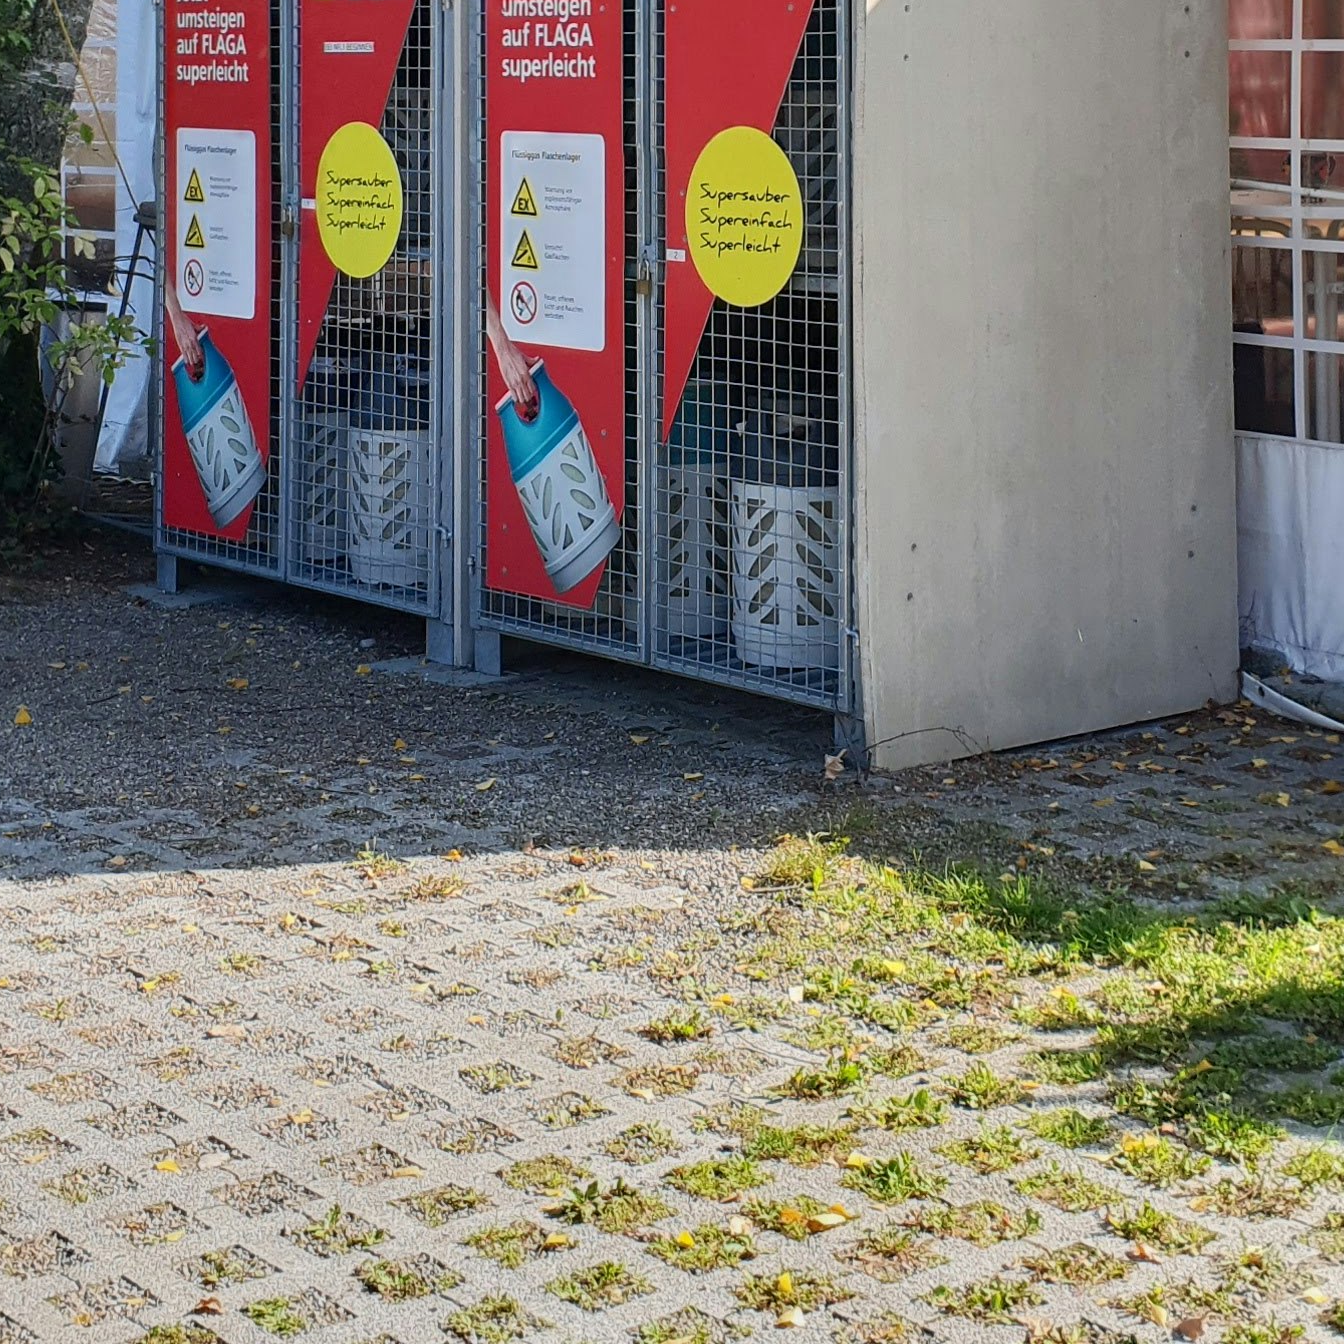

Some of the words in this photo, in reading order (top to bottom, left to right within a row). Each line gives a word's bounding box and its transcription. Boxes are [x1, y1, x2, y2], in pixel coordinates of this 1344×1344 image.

[176, 8, 245, 37] umsteigen
[501, 22, 530, 47] auf
[535, 23, 593, 47] FLAGA
[176, 35, 199, 55] auf
[201, 36, 247, 55] FLAGA
[176, 61, 249, 86] superleicht
[501, 52, 596, 83] superleicht
[326, 171, 393, 191] Supersauber
[326, 192, 395, 212] Supereinfach
[518, 197, 530, 212] EX
[699, 183, 791, 210] Supersauber
[326, 213, 386, 233] Superleicht
[699, 209, 793, 234] Supereinfach
[699, 233, 781, 258] Superleicht
